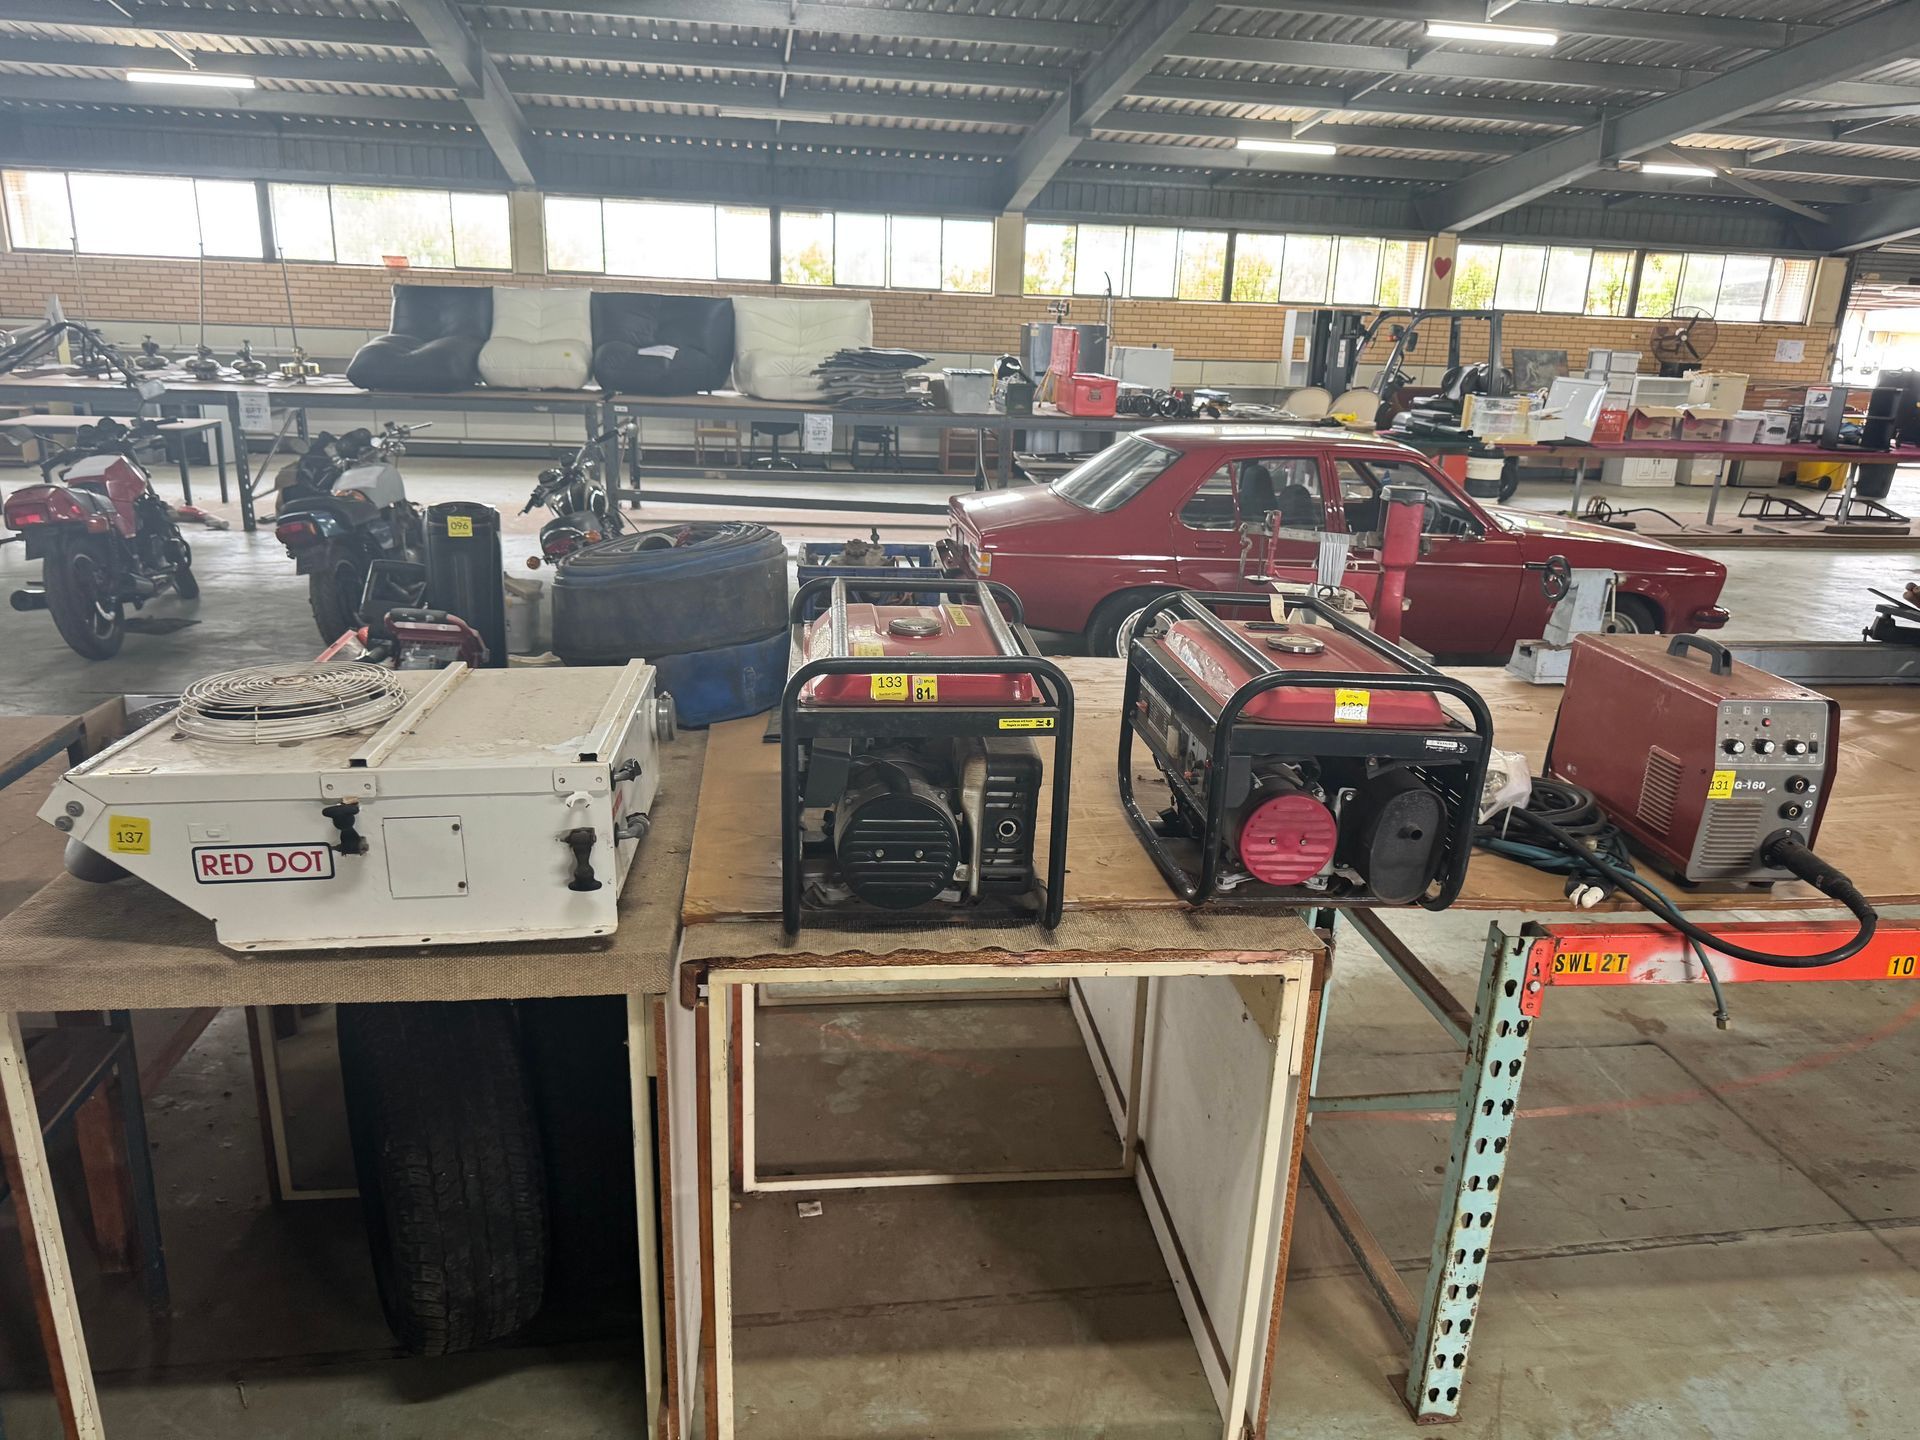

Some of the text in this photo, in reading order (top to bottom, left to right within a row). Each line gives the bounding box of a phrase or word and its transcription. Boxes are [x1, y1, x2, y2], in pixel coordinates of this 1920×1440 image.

[450, 521, 469, 530] 096
[877, 675, 903, 689] 133
[916, 687, 931, 700] 81
[1710, 780, 1729, 790] 131
[116, 831, 144, 844] 137
[201, 850, 323, 876] RED DOT
[1554, 953, 1593, 973] SWL
[1893, 956, 1915, 975] 10
